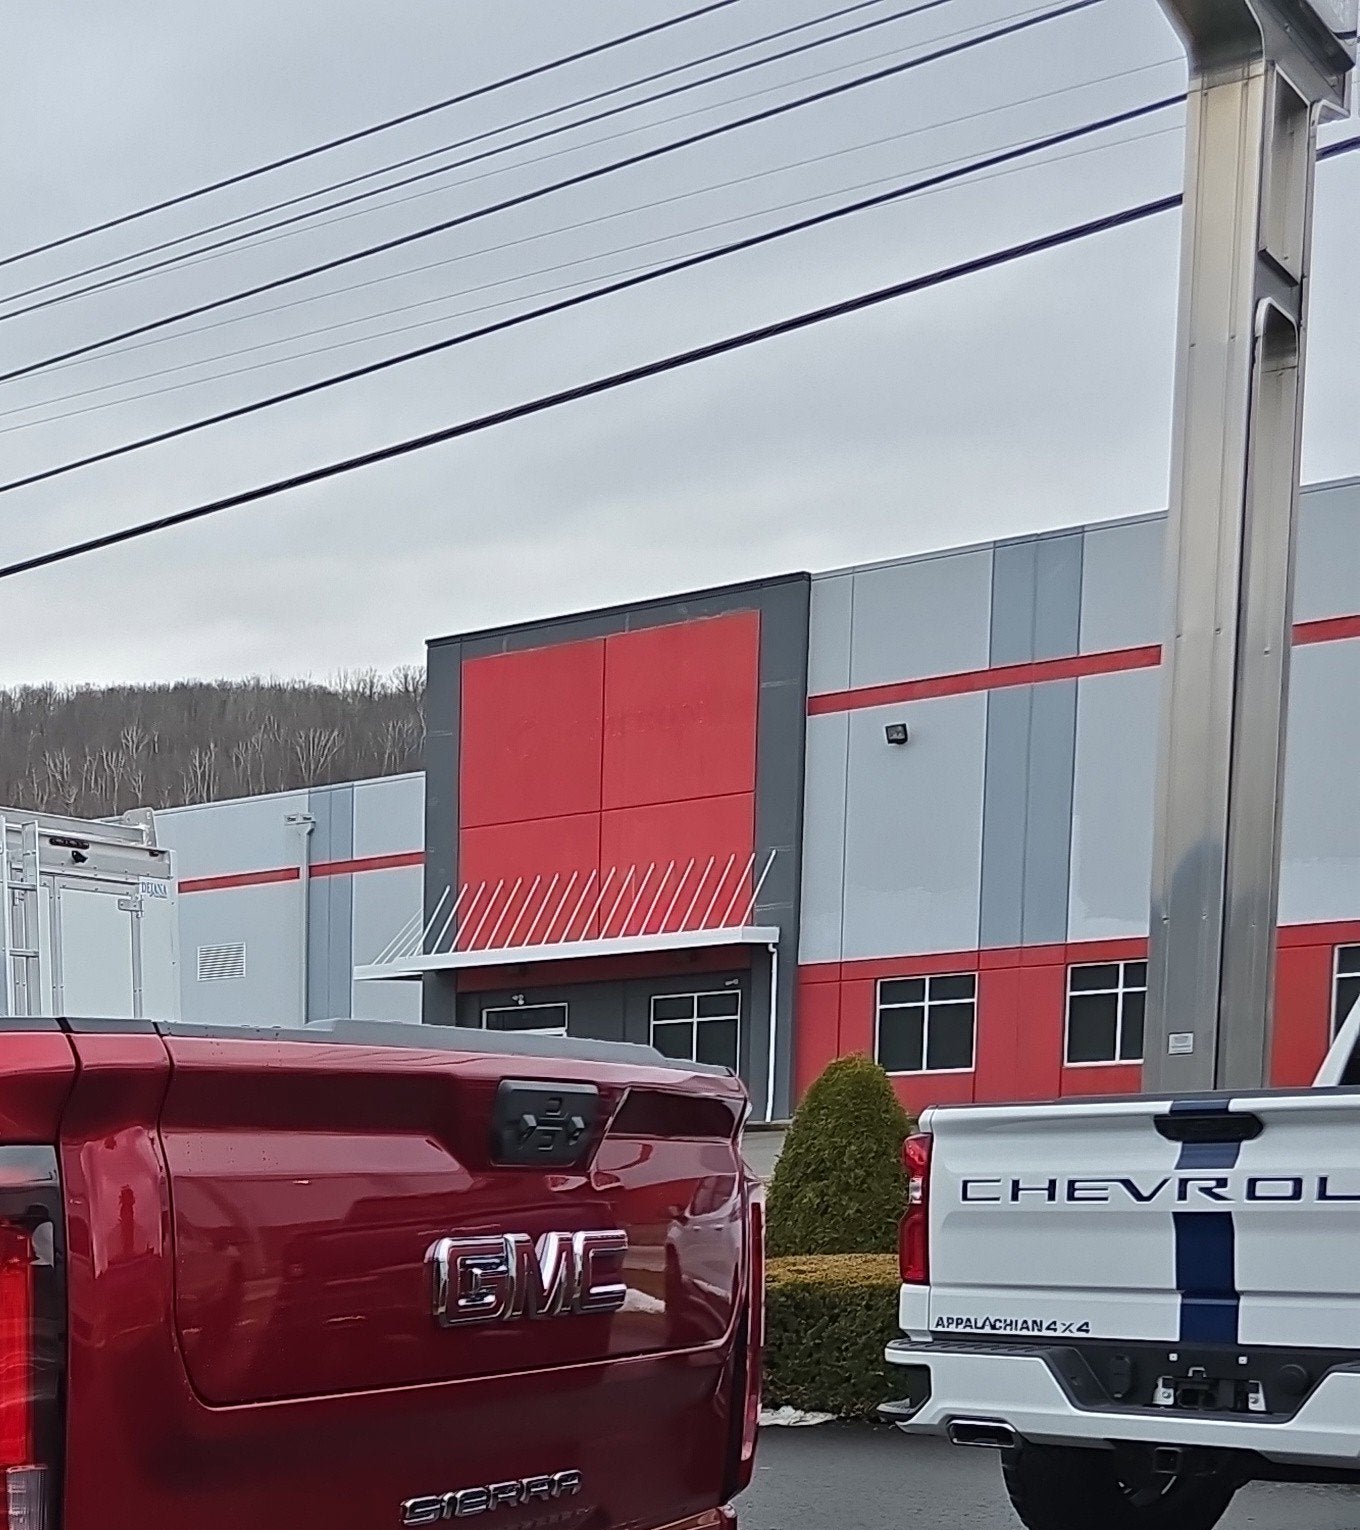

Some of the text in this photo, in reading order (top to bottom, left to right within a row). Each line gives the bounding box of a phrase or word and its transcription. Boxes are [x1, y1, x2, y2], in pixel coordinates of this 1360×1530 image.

[424, 1229, 629, 1328] GMC
[935, 1315, 1043, 1332] APPALACHIAN
[398, 1469, 584, 1527] SIERRA
